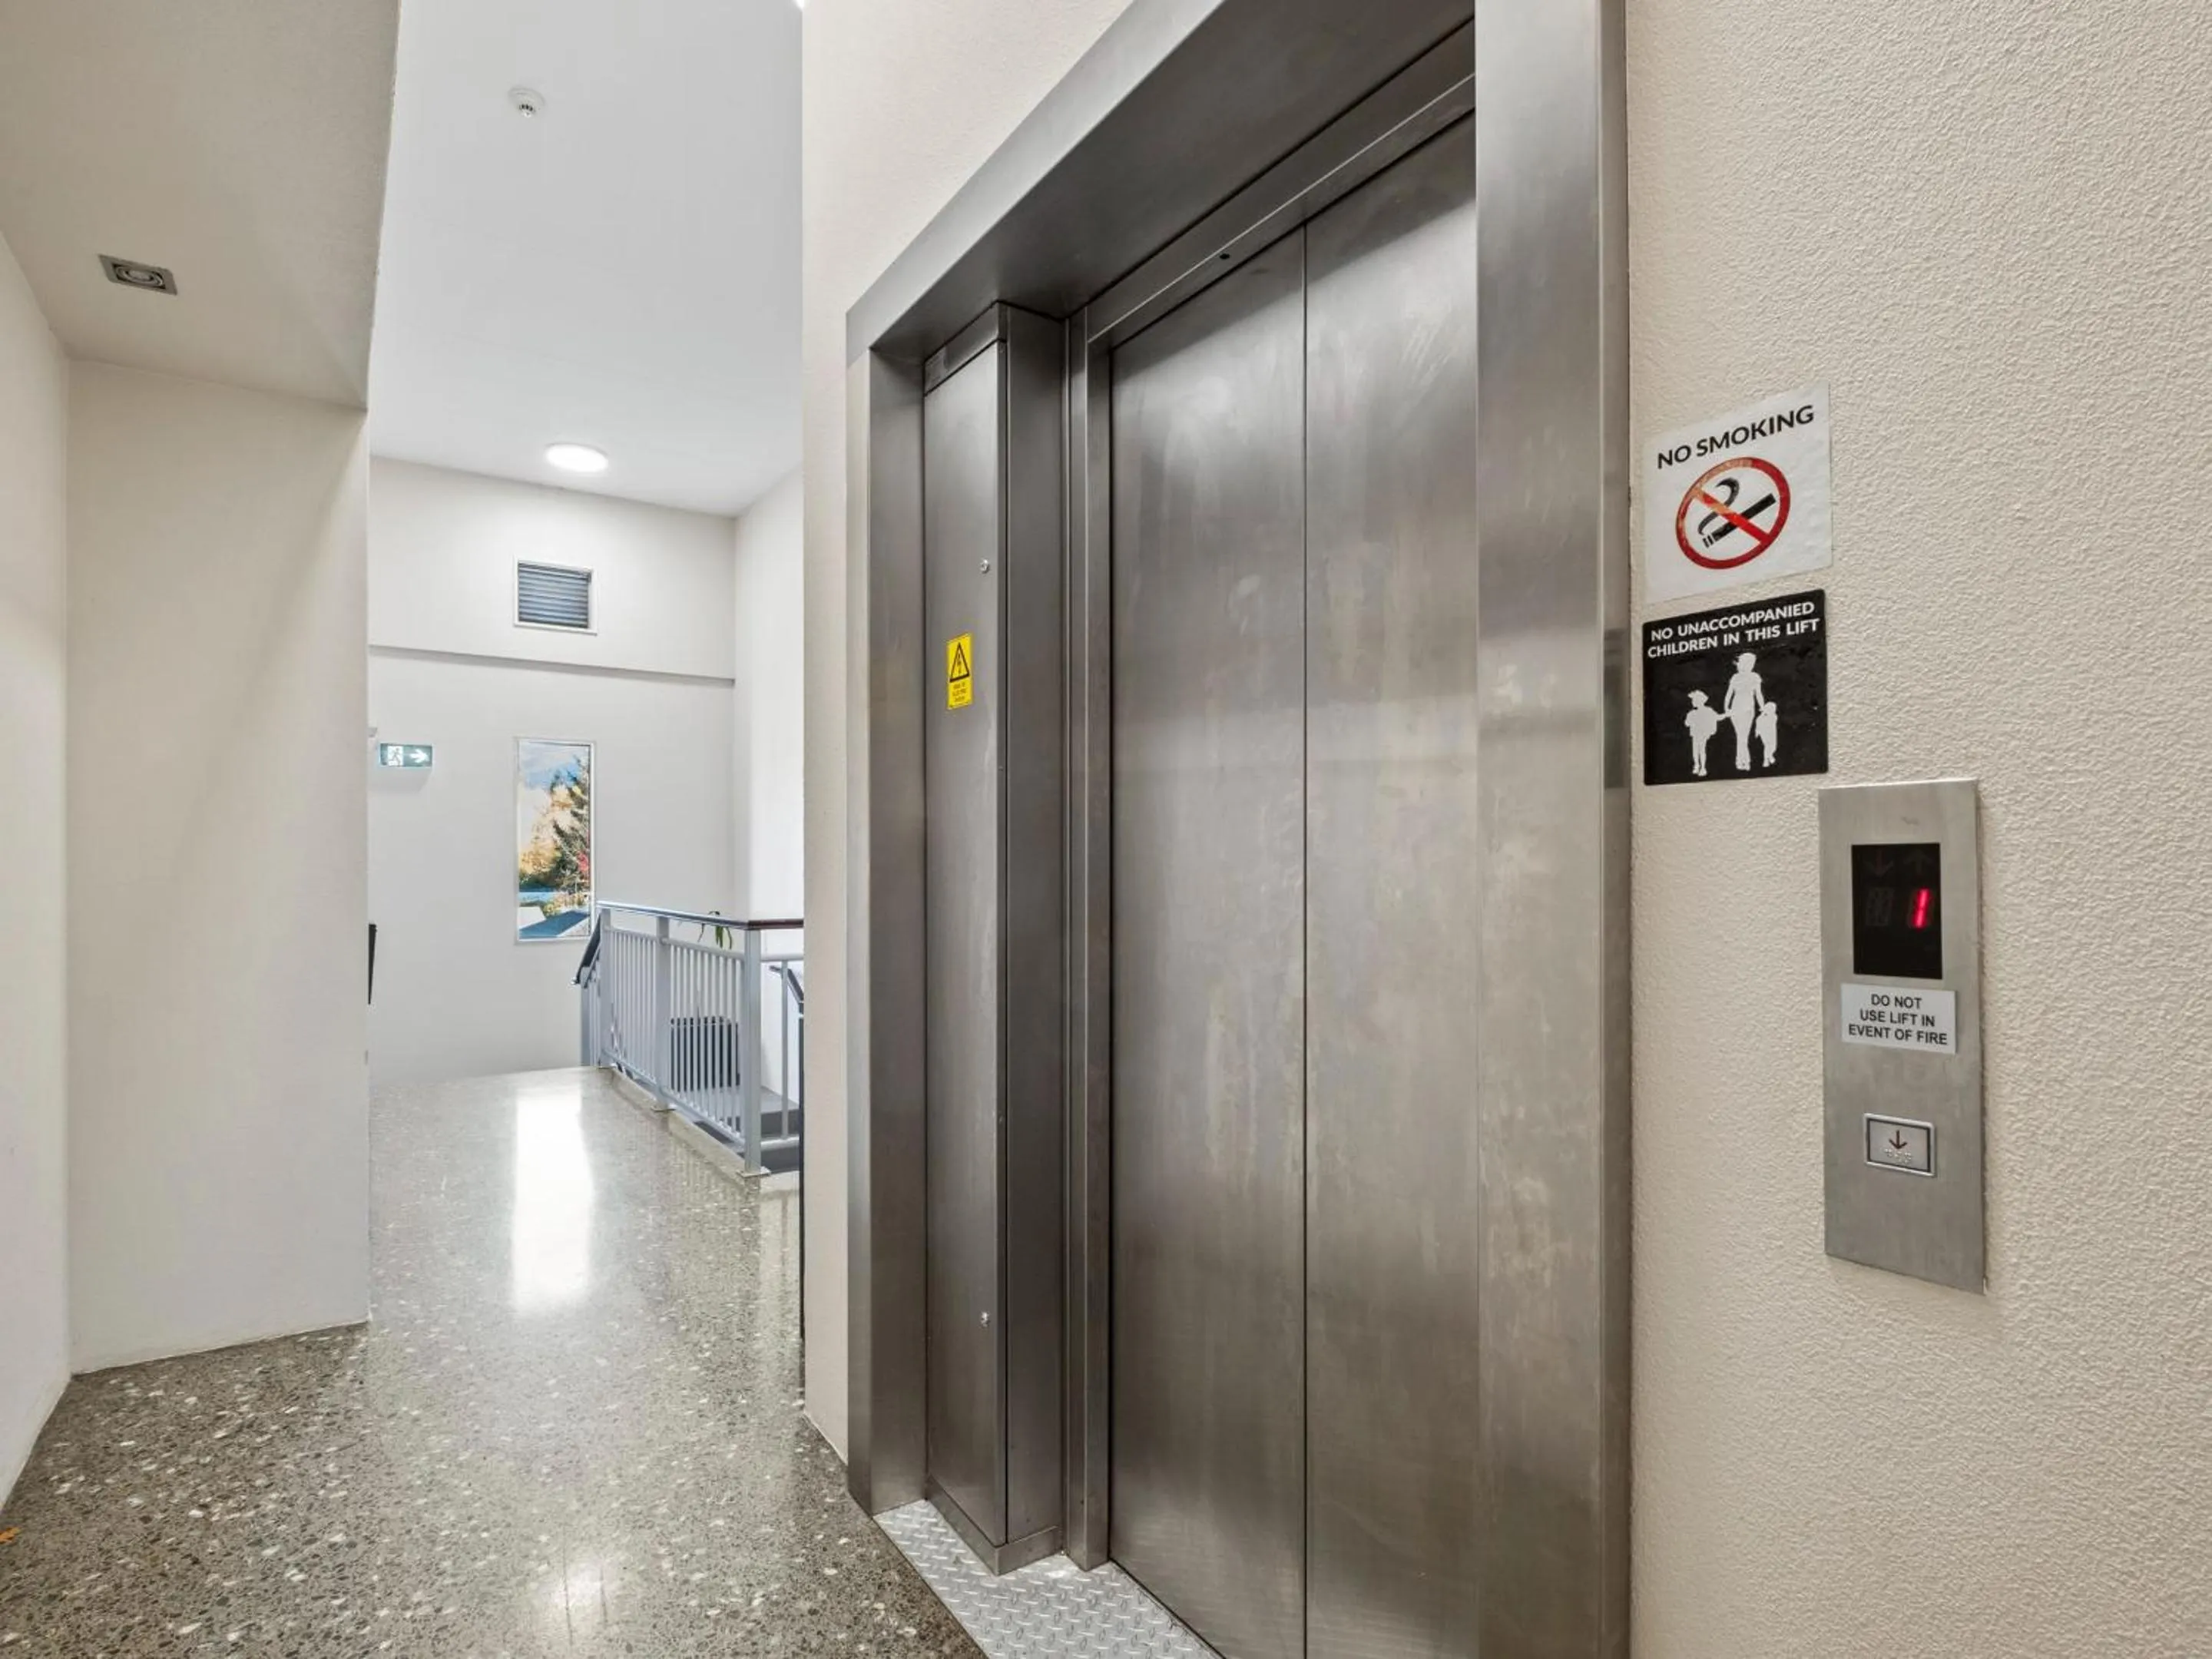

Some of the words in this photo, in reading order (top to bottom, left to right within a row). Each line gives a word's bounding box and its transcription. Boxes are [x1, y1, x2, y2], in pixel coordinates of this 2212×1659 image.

[1657, 445, 1691, 469] NO
[1696, 405, 1814, 457] SMOKING
[1651, 628, 1673, 641] NO
[1677, 601, 1815, 636] UNACCOMPANIED
[1647, 636, 1718, 658] CHILDREN
[1723, 632, 1740, 646] IN
[1745, 624, 1780, 642] THIS
[1786, 618, 1820, 635] LIFT
[1870, 993, 1891, 1007] DO
[1893, 995, 1922, 1009] NOT
[1859, 1008, 1886, 1022] USE
[1889, 1012, 1918, 1025] LIFT
[1921, 1014, 1936, 1028] IN
[1848, 1023, 1891, 1039] EVENT
[1894, 1028, 1912, 1041] OF
[1916, 1029, 1948, 1045] FIRE
